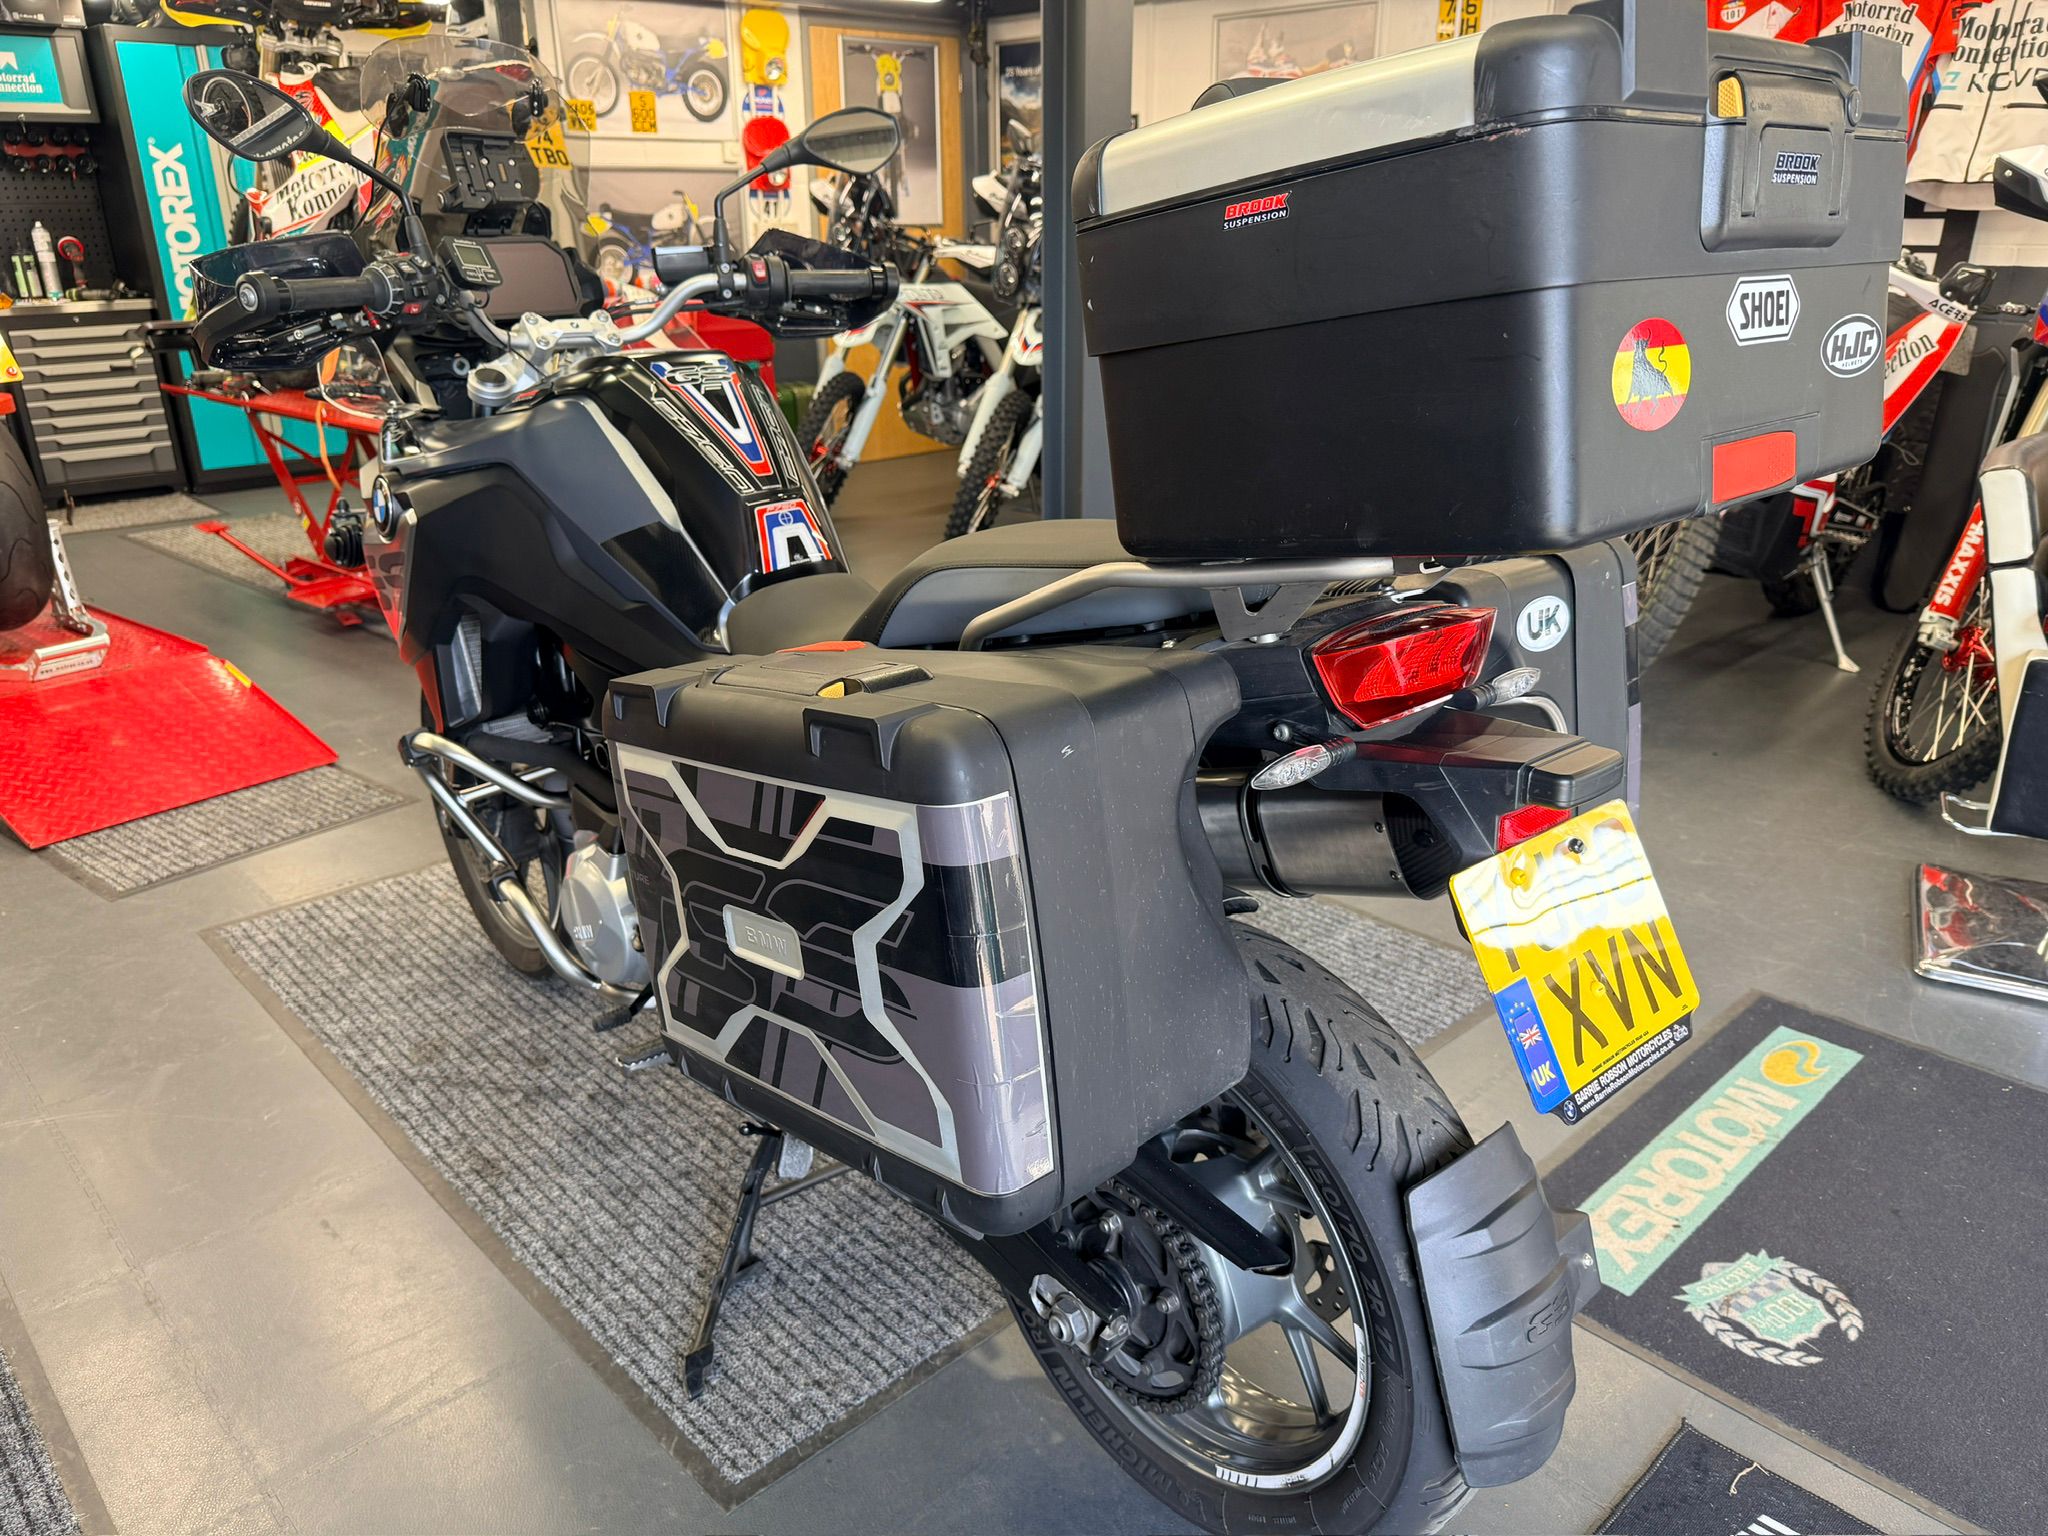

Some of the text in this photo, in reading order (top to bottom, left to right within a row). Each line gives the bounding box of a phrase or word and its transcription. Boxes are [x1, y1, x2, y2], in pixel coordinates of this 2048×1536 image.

[0, 83, 43, 94] nnection
[1771, 173, 1817, 186] SUSPENSION
[1774, 151, 1822, 173] BROOK
[1223, 209, 1287, 230] SUSPENSION
[1225, 192, 1289, 220] BROOK
[147, 142, 204, 312] OTOREX
[1739, 289, 1790, 331] SHOEI
[1829, 328, 1876, 364] HJC
[1934, 519, 1985, 607] MAXXIS
[1526, 604, 1561, 641] UK
[744, 924, 788, 955] BMW
[1542, 919, 1683, 1068] XVN
[1530, 1059, 1556, 1088] UK
[1574, 1079, 1602, 1106] BARRIE
[1598, 1063, 1629, 1087] ROBSON
[1625, 1028, 1674, 1068] MOTORCYCLES
[1590, 1077, 1800, 1275] MOTOREX
[1050, 1366, 1173, 1491] MICHELIN
